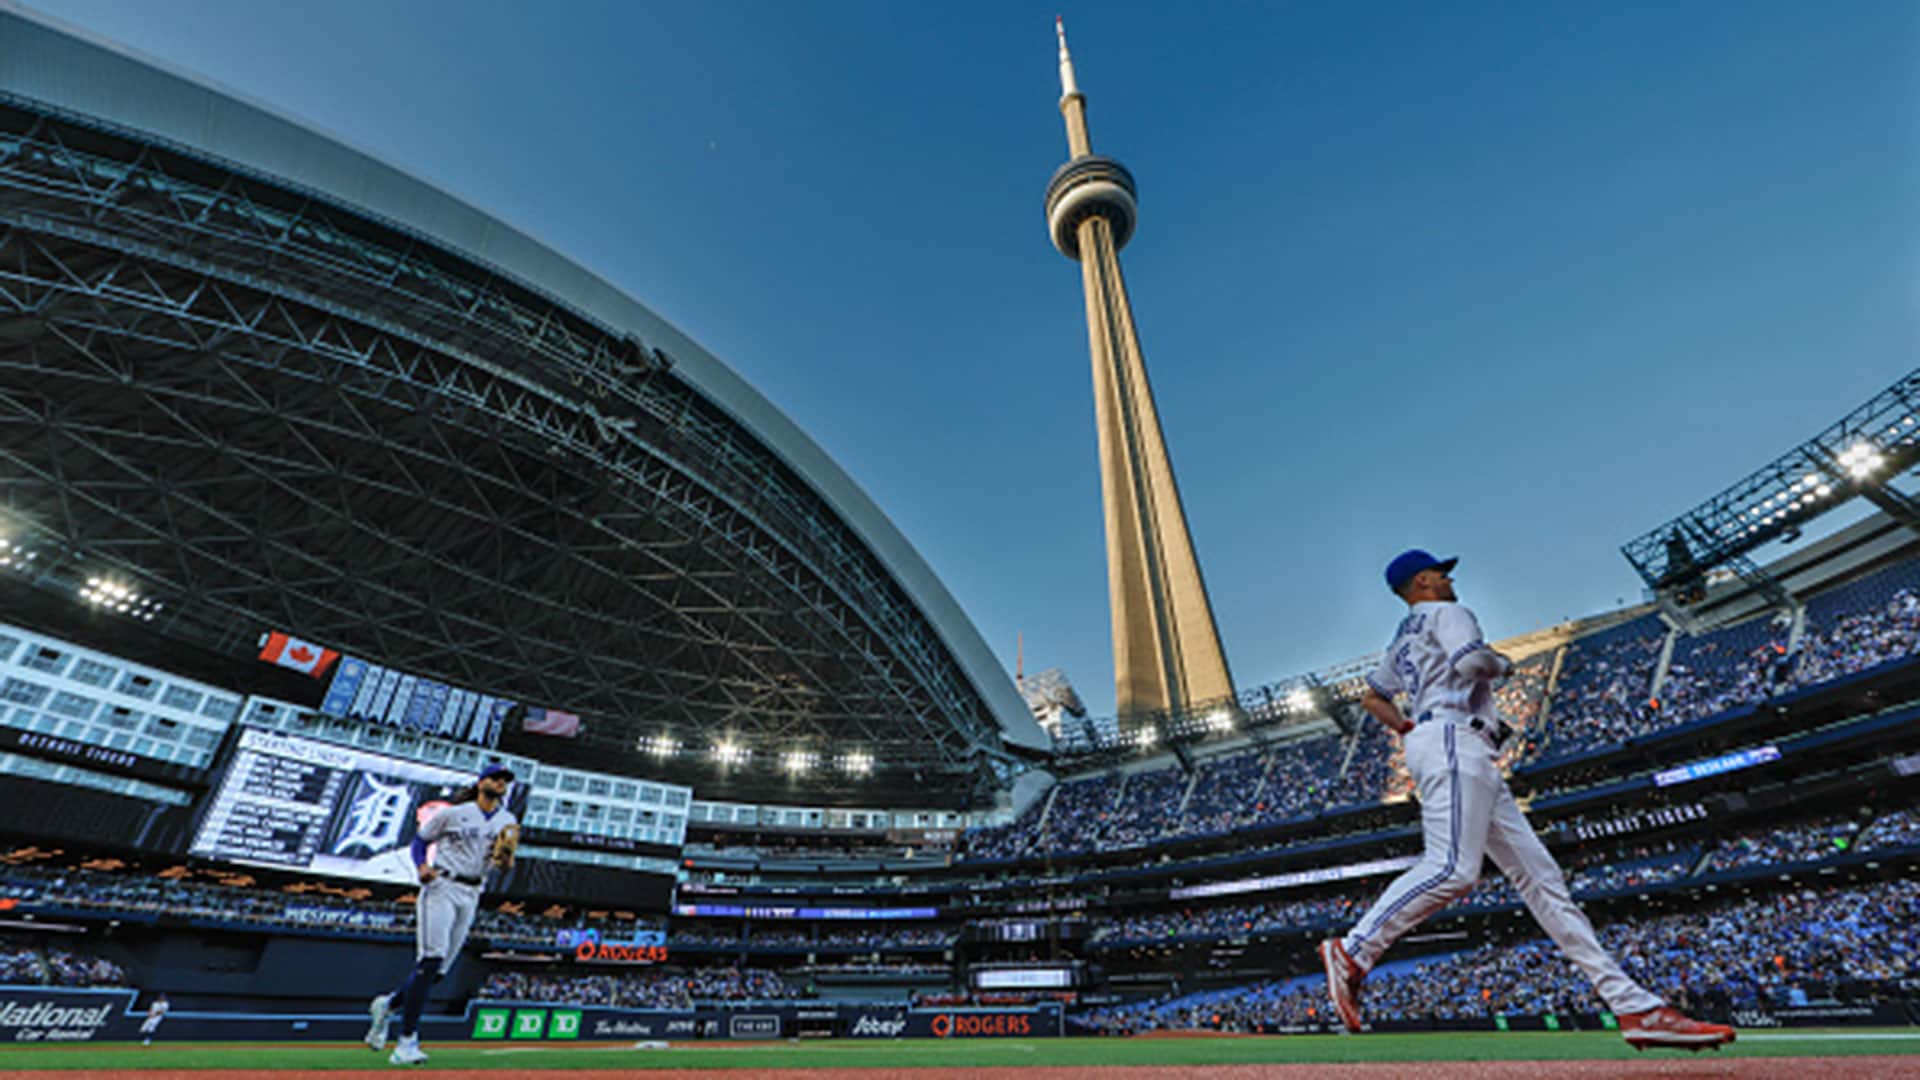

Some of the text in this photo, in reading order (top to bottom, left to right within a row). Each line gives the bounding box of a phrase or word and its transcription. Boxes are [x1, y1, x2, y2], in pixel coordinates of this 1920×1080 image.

[18, 733, 136, 767] DETROIT TIGERS
[1577, 803, 1708, 840] DETROIT TIGERS
[598, 943, 668, 961] ROGERS
[481, 1014, 506, 1033] TD
[518, 1014, 543, 1033] TD
[555, 1014, 579, 1033] TD
[955, 1014, 1031, 1035] ROGERS
